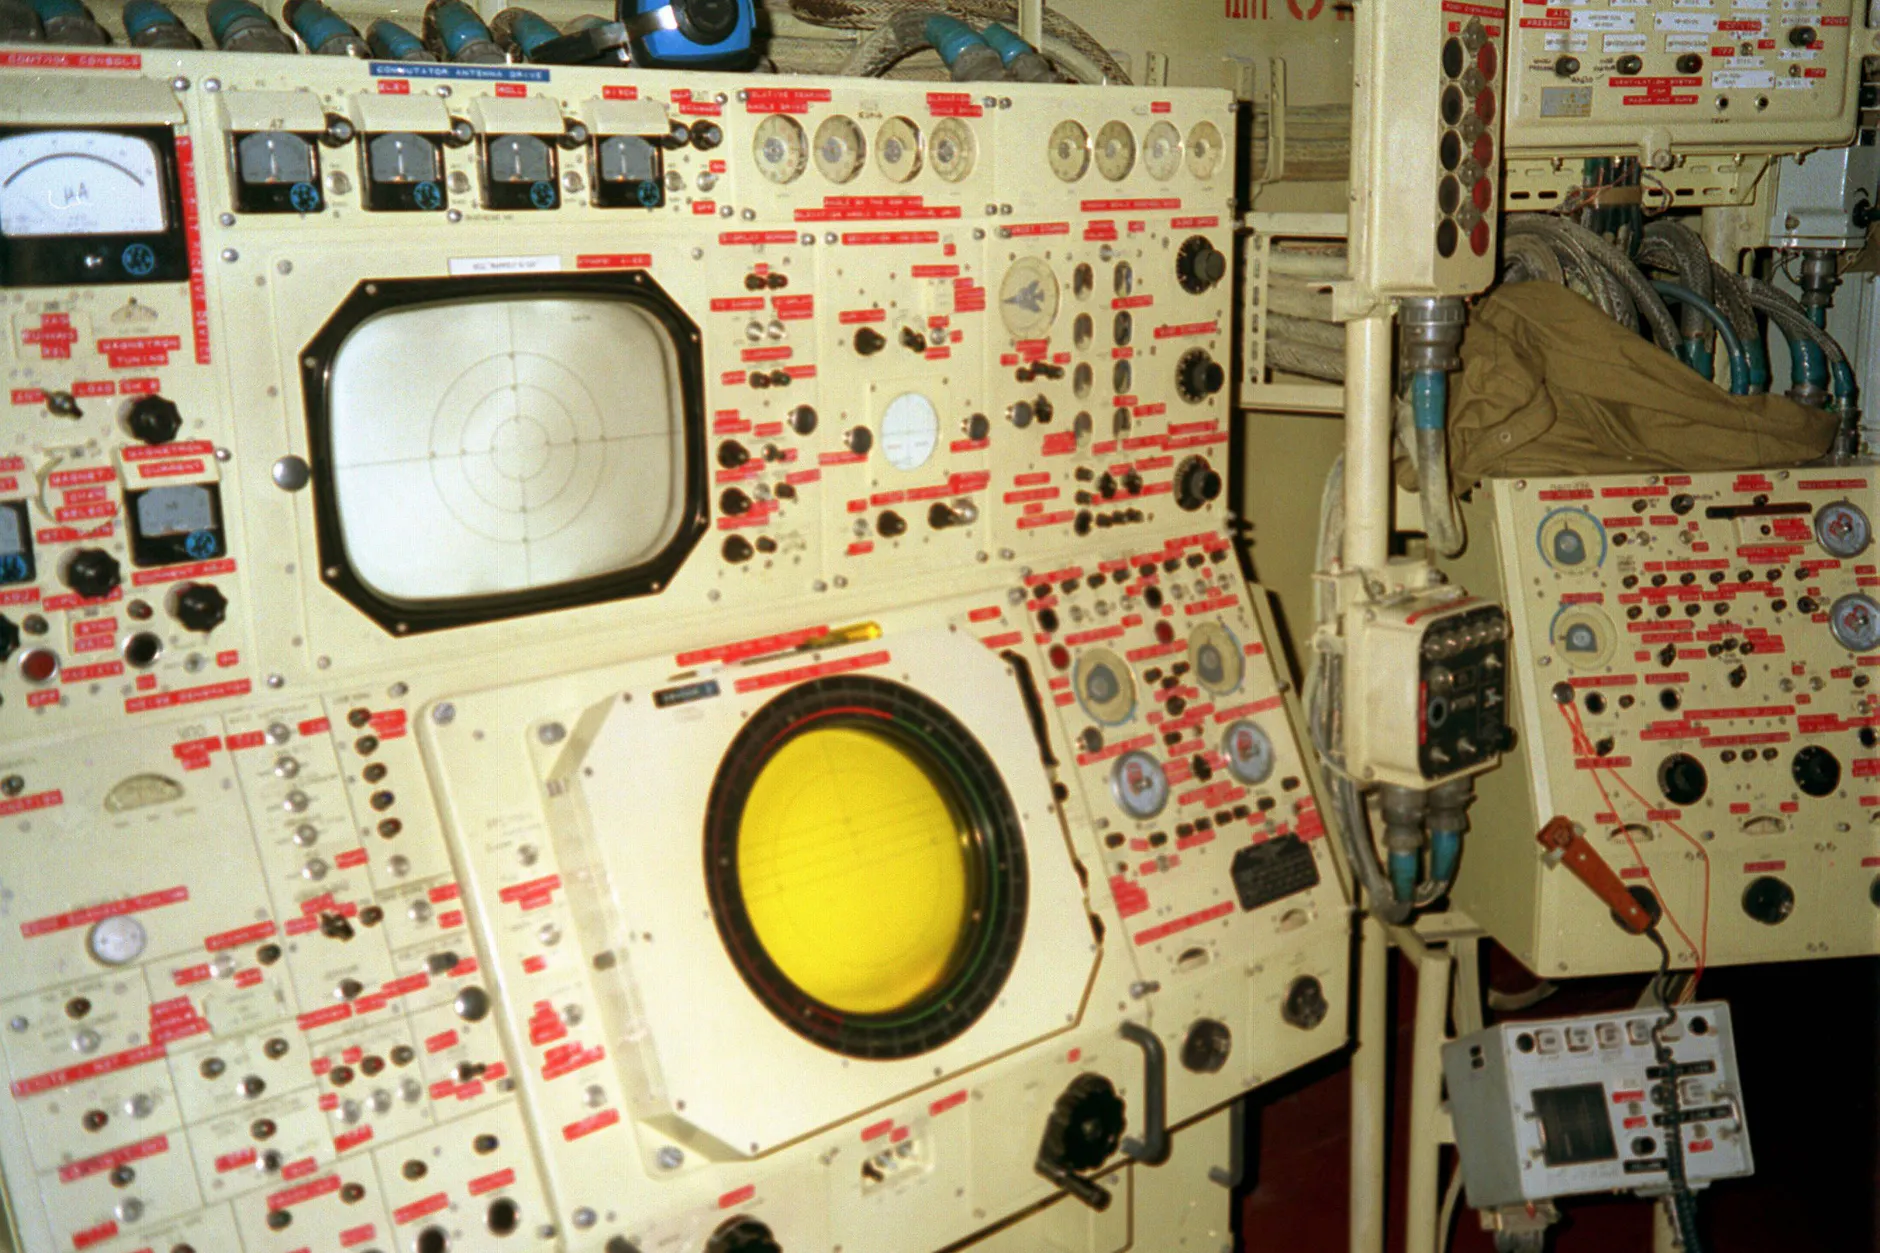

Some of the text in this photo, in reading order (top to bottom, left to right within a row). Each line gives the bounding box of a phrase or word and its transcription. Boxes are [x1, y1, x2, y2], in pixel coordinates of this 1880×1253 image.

[376, 66, 542, 79] COMMUTATOR ANTENNA DRIVE
